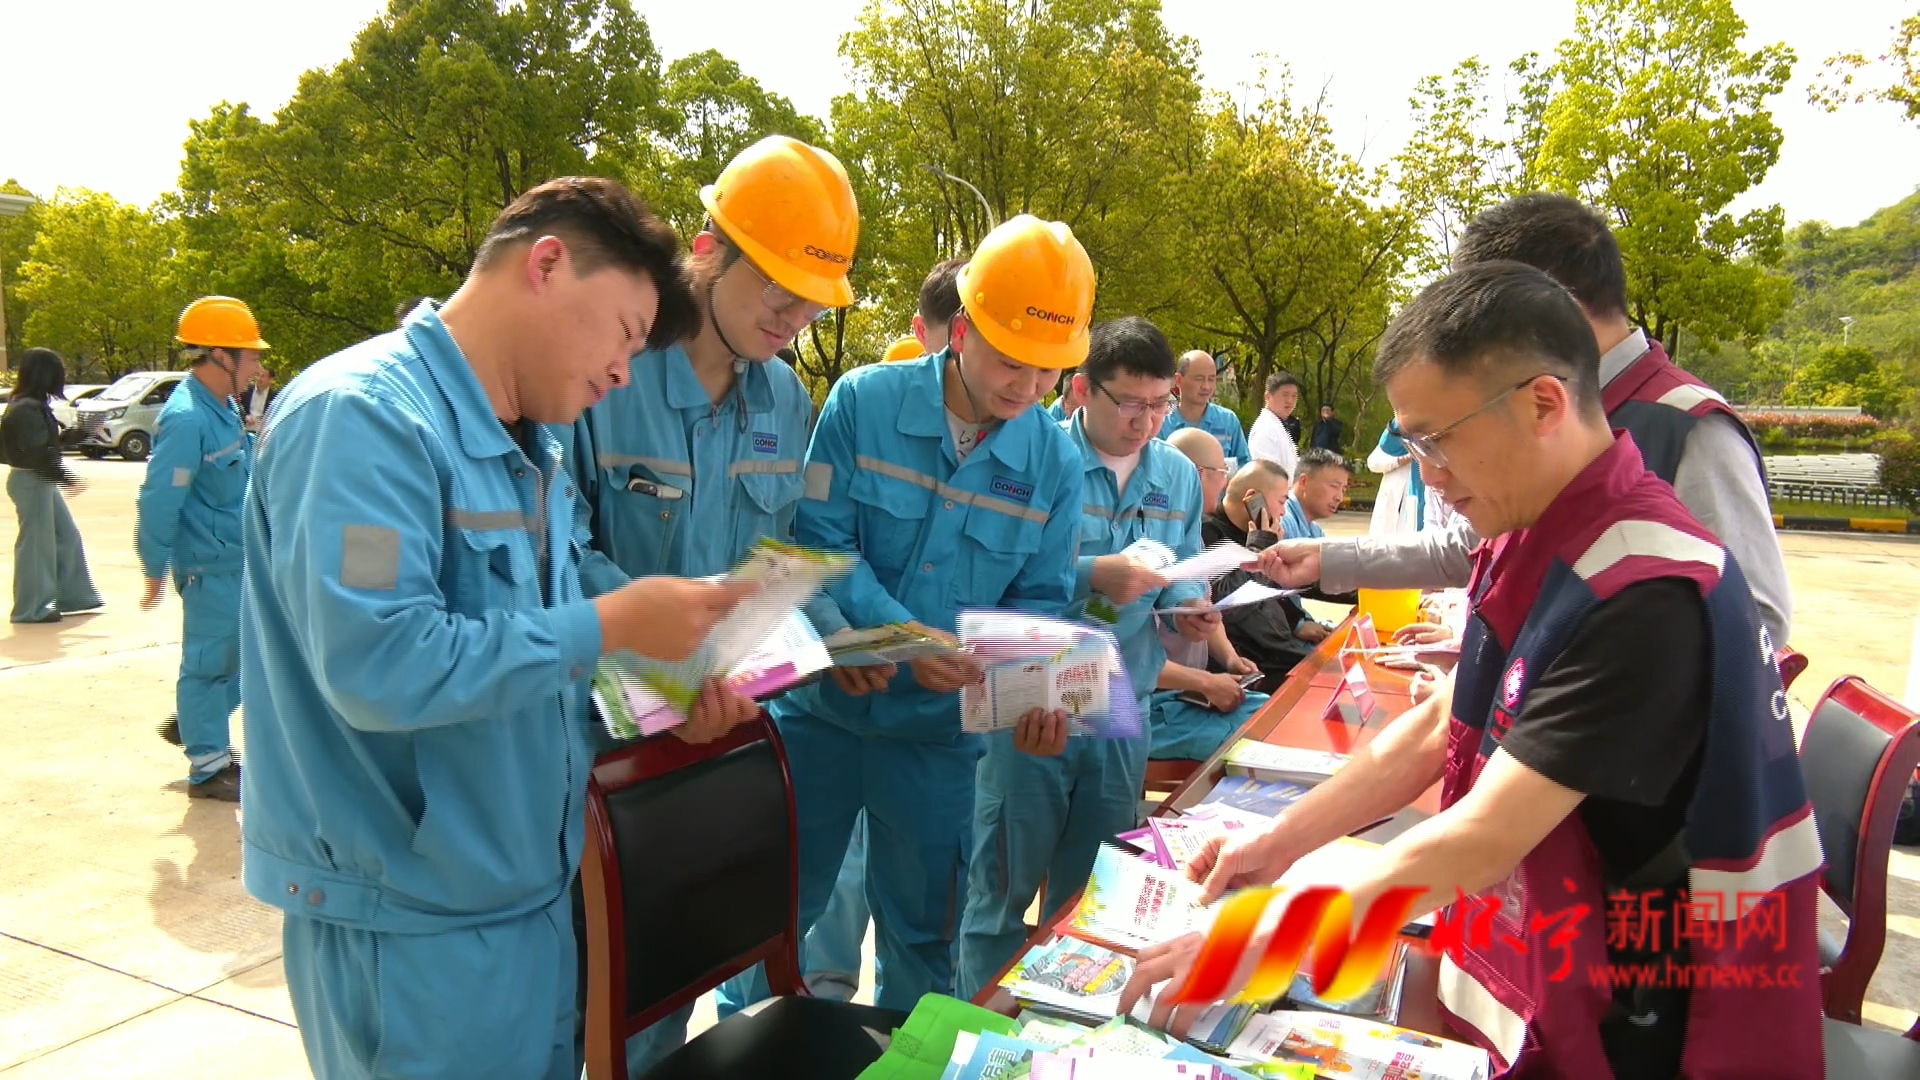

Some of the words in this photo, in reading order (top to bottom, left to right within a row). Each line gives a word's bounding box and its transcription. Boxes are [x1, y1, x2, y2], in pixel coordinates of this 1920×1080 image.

[803, 244, 848, 264] CONCH
[1026, 306, 1075, 325] CONCH
[994, 481, 1030, 497] CONCH
